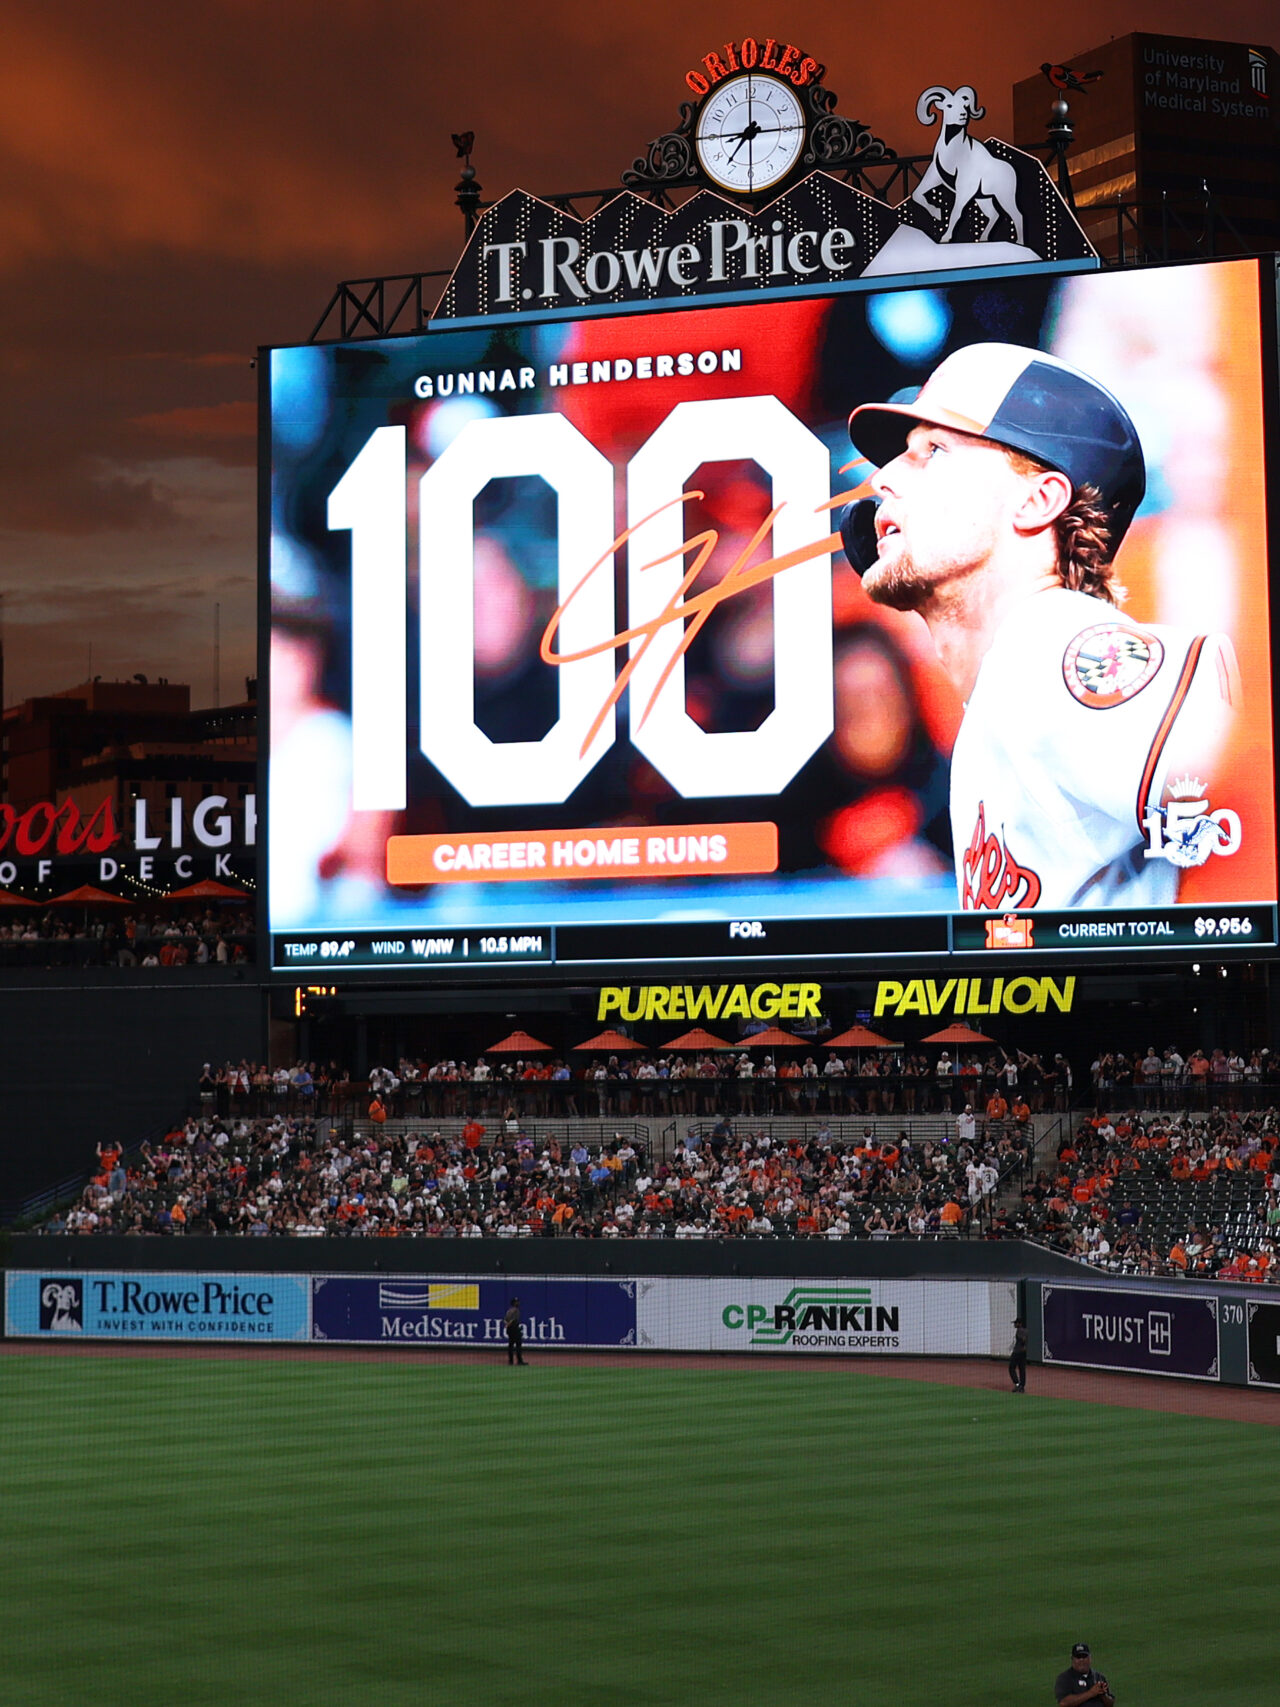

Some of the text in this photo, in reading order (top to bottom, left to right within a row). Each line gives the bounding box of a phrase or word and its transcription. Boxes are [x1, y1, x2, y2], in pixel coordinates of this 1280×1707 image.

[685, 37, 817, 95] ORIOLES
[1144, 48, 1225, 73] University
[1145, 71, 1240, 93] of Maryland
[1145, 91, 1269, 118] Medical System
[414, 349, 742, 399] GUNNAR HENDERSON
[327, 394, 834, 810] 100
[433, 835, 727, 872] CAREER HOME RUNS
[100, 853, 231, 881] DECK
[729, 922, 766, 939] FOR.
[1059, 917, 1252, 937] CURRENT TOTAL $9,956
[284, 943, 317, 956] TEMP
[371, 941, 405, 954] WIND
[411, 938, 454, 958] W/NW
[479, 937, 508, 954] 10.5
[510, 936, 542, 952] MPH
[598, 976, 1076, 1021] PUREWAGER PAVILION
[98, 1319, 274, 1333] INVEST WITH CONFIDENCE
[381, 1315, 477, 1338] MedStar
[774, 1305, 899, 1331] RANKIN
[1222, 1304, 1244, 1325] 370
[1082, 1313, 1145, 1343] TRUIST
[792, 1335, 899, 1347] ROOFING EXPERTS
